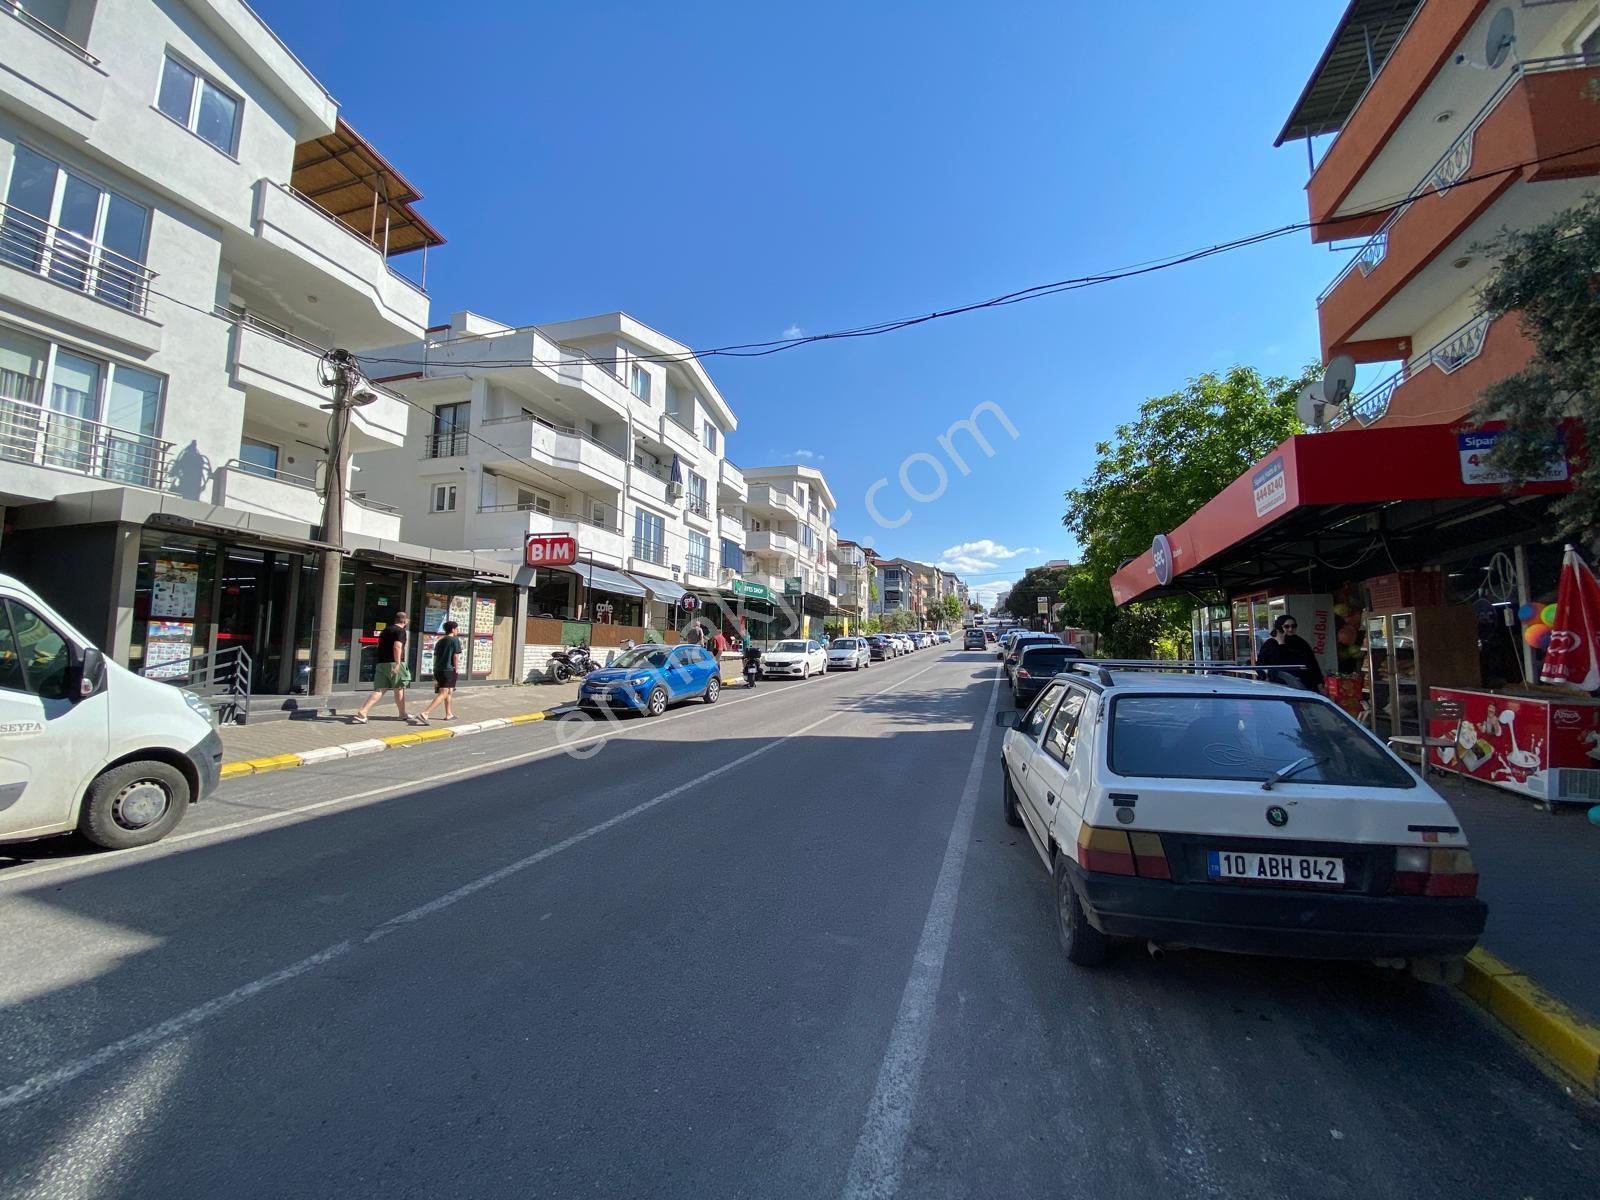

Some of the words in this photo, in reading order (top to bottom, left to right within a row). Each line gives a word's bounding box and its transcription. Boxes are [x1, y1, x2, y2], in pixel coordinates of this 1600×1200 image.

[531, 538, 569, 561] BİM
[1223, 854, 1247, 876] 10
[1257, 856, 1293, 879] ABH
[1299, 859, 1338, 881] 842
